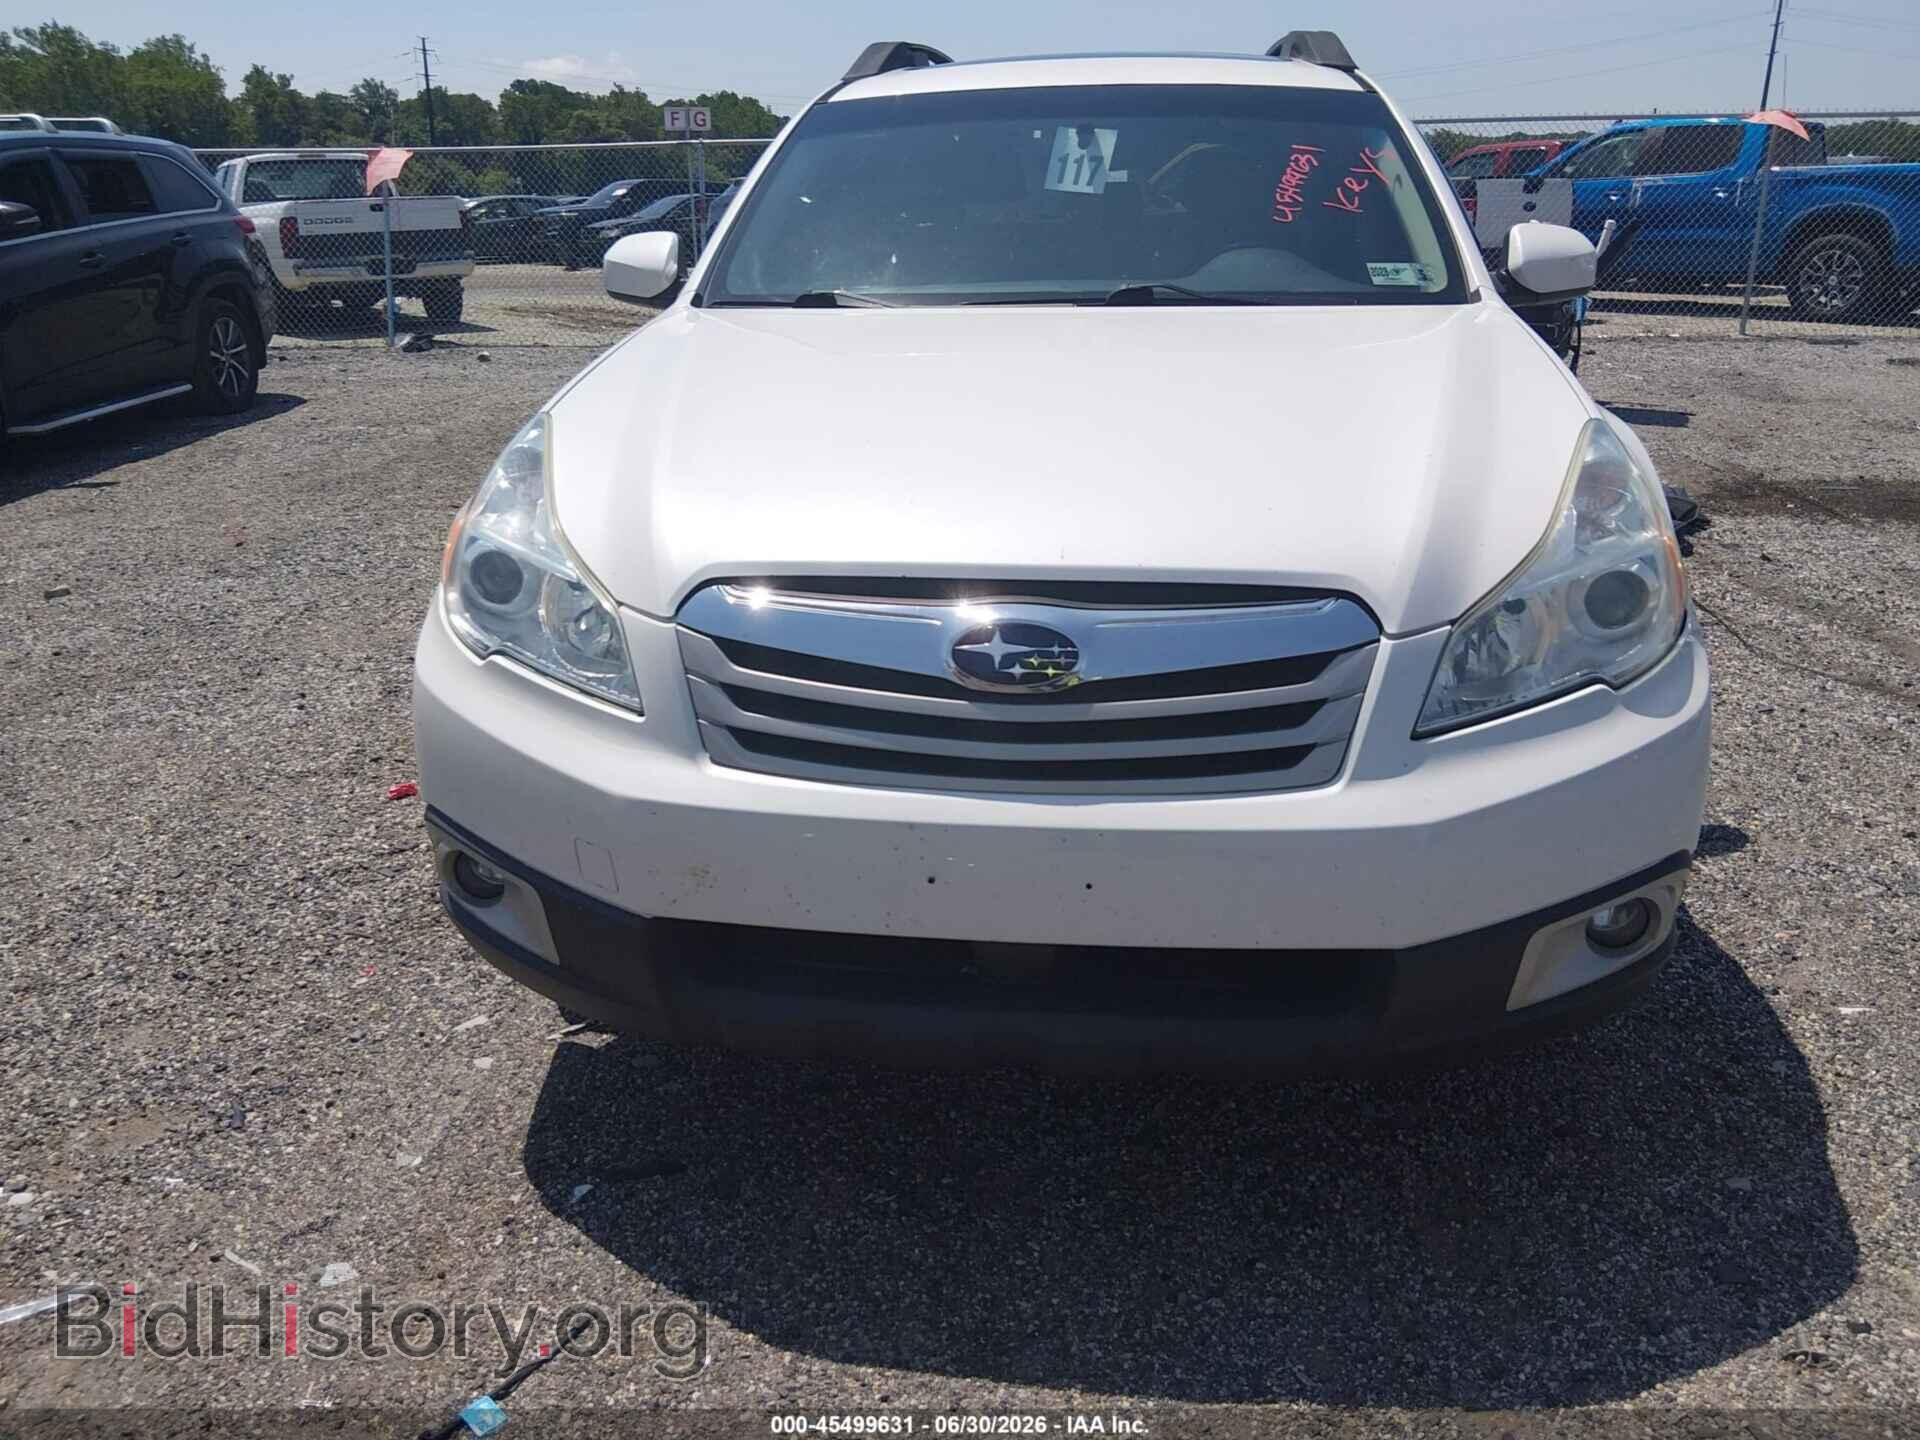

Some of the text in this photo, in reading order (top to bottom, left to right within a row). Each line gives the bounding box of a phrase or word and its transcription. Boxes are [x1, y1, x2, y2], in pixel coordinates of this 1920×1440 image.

[670, 111, 680, 127] F
[694, 111, 706, 128] G
[1056, 152, 1105, 186] 117
